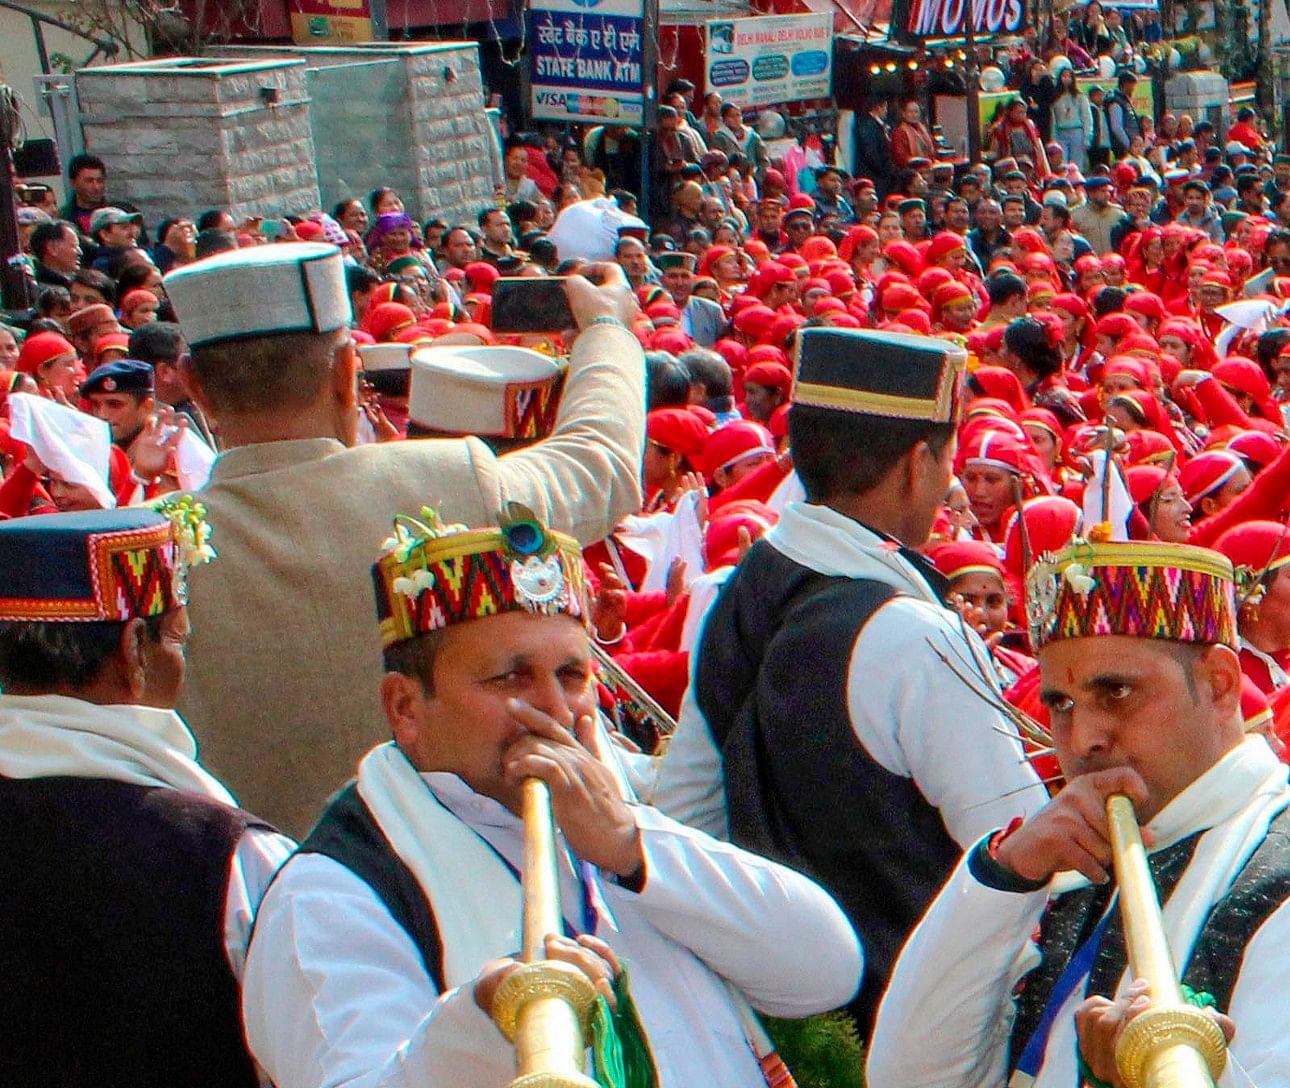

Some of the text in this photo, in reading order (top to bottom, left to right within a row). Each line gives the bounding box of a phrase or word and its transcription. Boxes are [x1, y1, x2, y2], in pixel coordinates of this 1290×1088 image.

[537, 56, 640, 82] STATE BANK ATM
[536, 92, 567, 106] VISA
